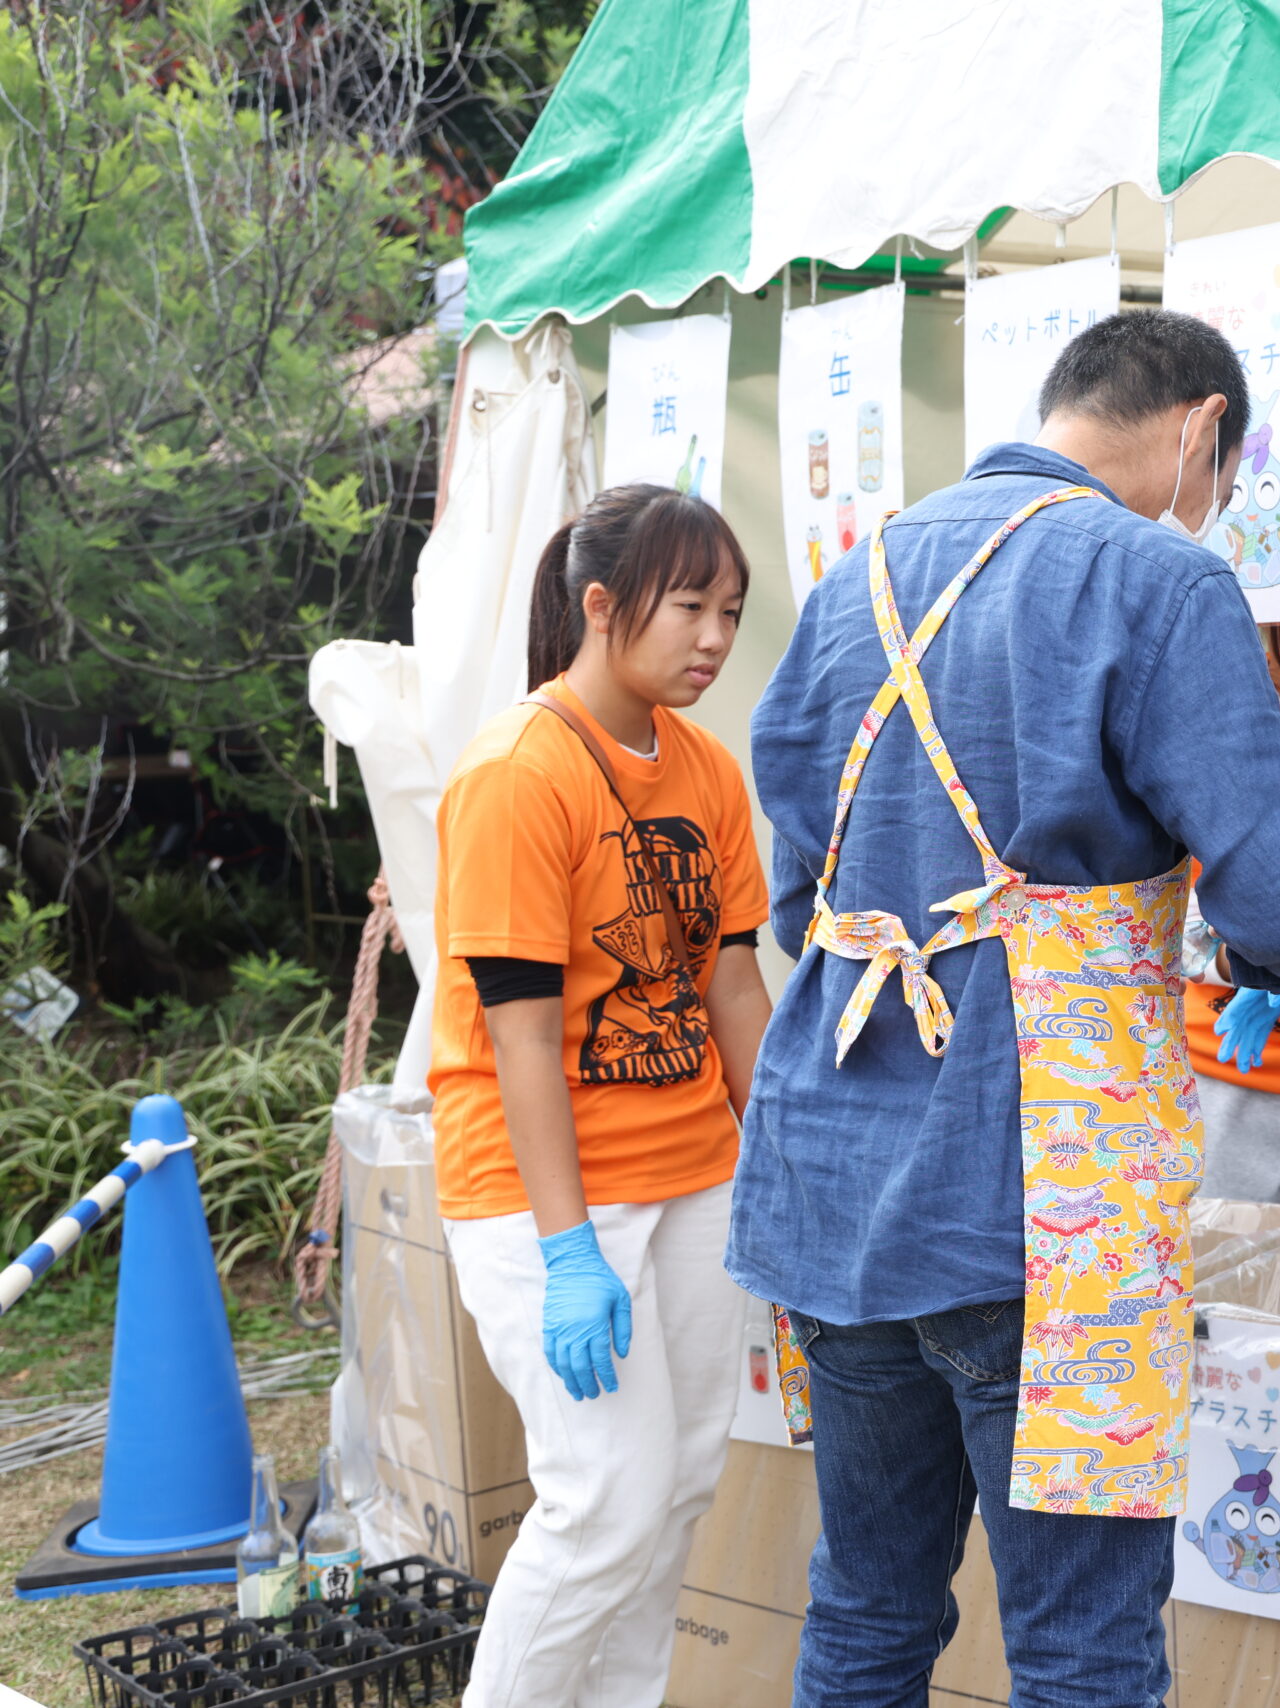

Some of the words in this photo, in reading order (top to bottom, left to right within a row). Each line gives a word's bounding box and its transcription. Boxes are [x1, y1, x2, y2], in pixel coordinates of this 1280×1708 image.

[828, 350, 852, 397] 缶
[651, 395, 678, 437] 瓶
[479, 1509, 525, 1538] garb
[674, 1616, 729, 1647] arbage
